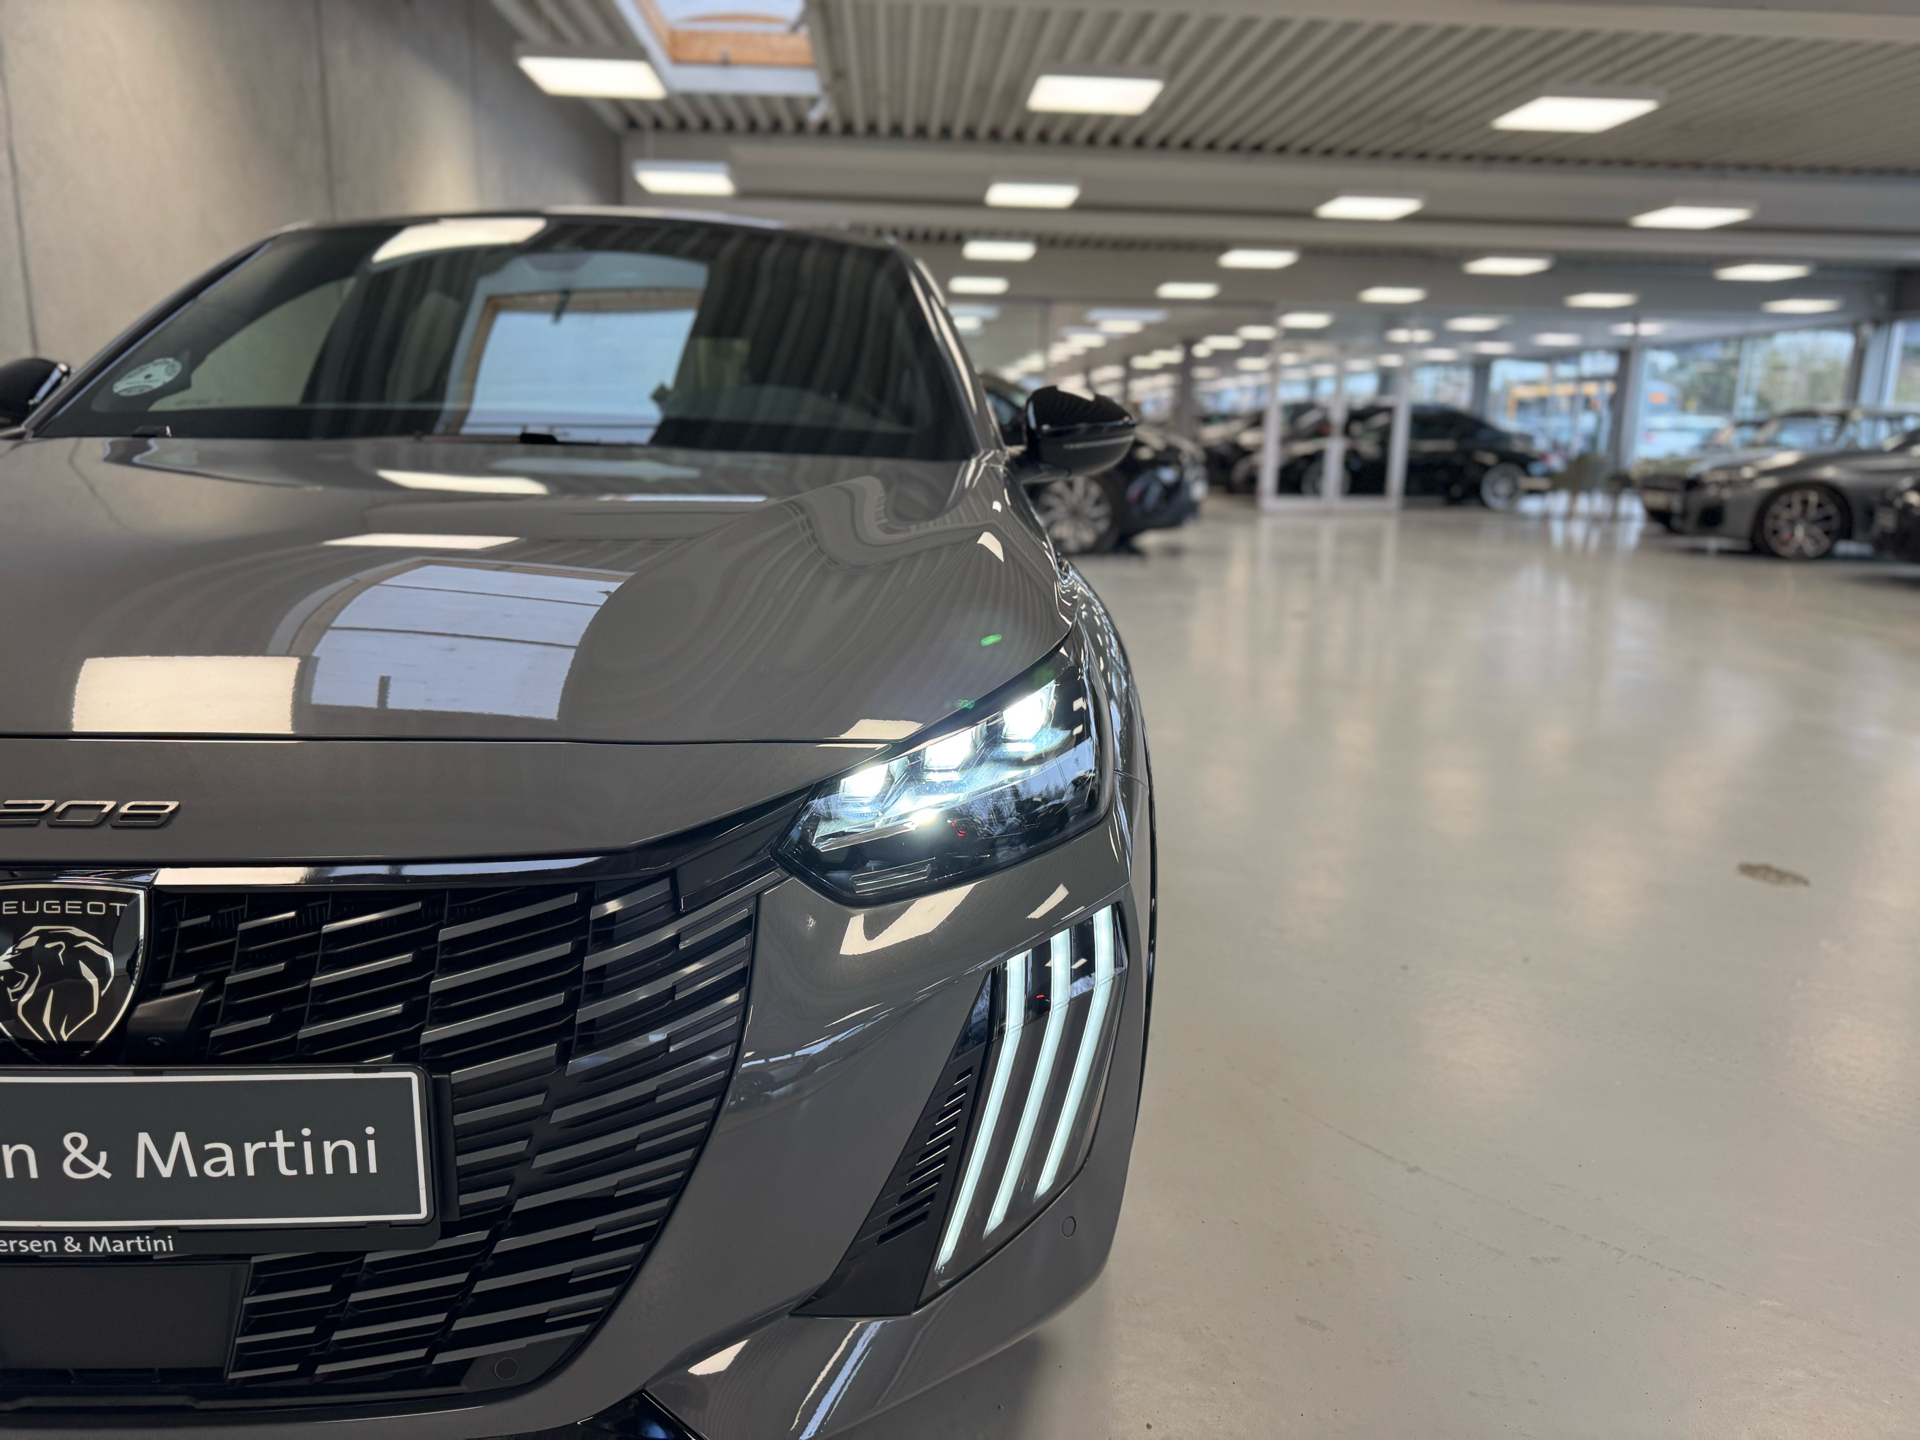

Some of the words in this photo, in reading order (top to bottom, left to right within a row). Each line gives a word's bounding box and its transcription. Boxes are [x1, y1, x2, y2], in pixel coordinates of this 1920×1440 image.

[0, 799, 181, 828] 208
[62, 1131, 112, 1179] &
[136, 1126, 378, 1178] Martini
[0, 1239, 57, 1253] ersen
[64, 1235, 83, 1253] &
[89, 1235, 174, 1253] Martini
